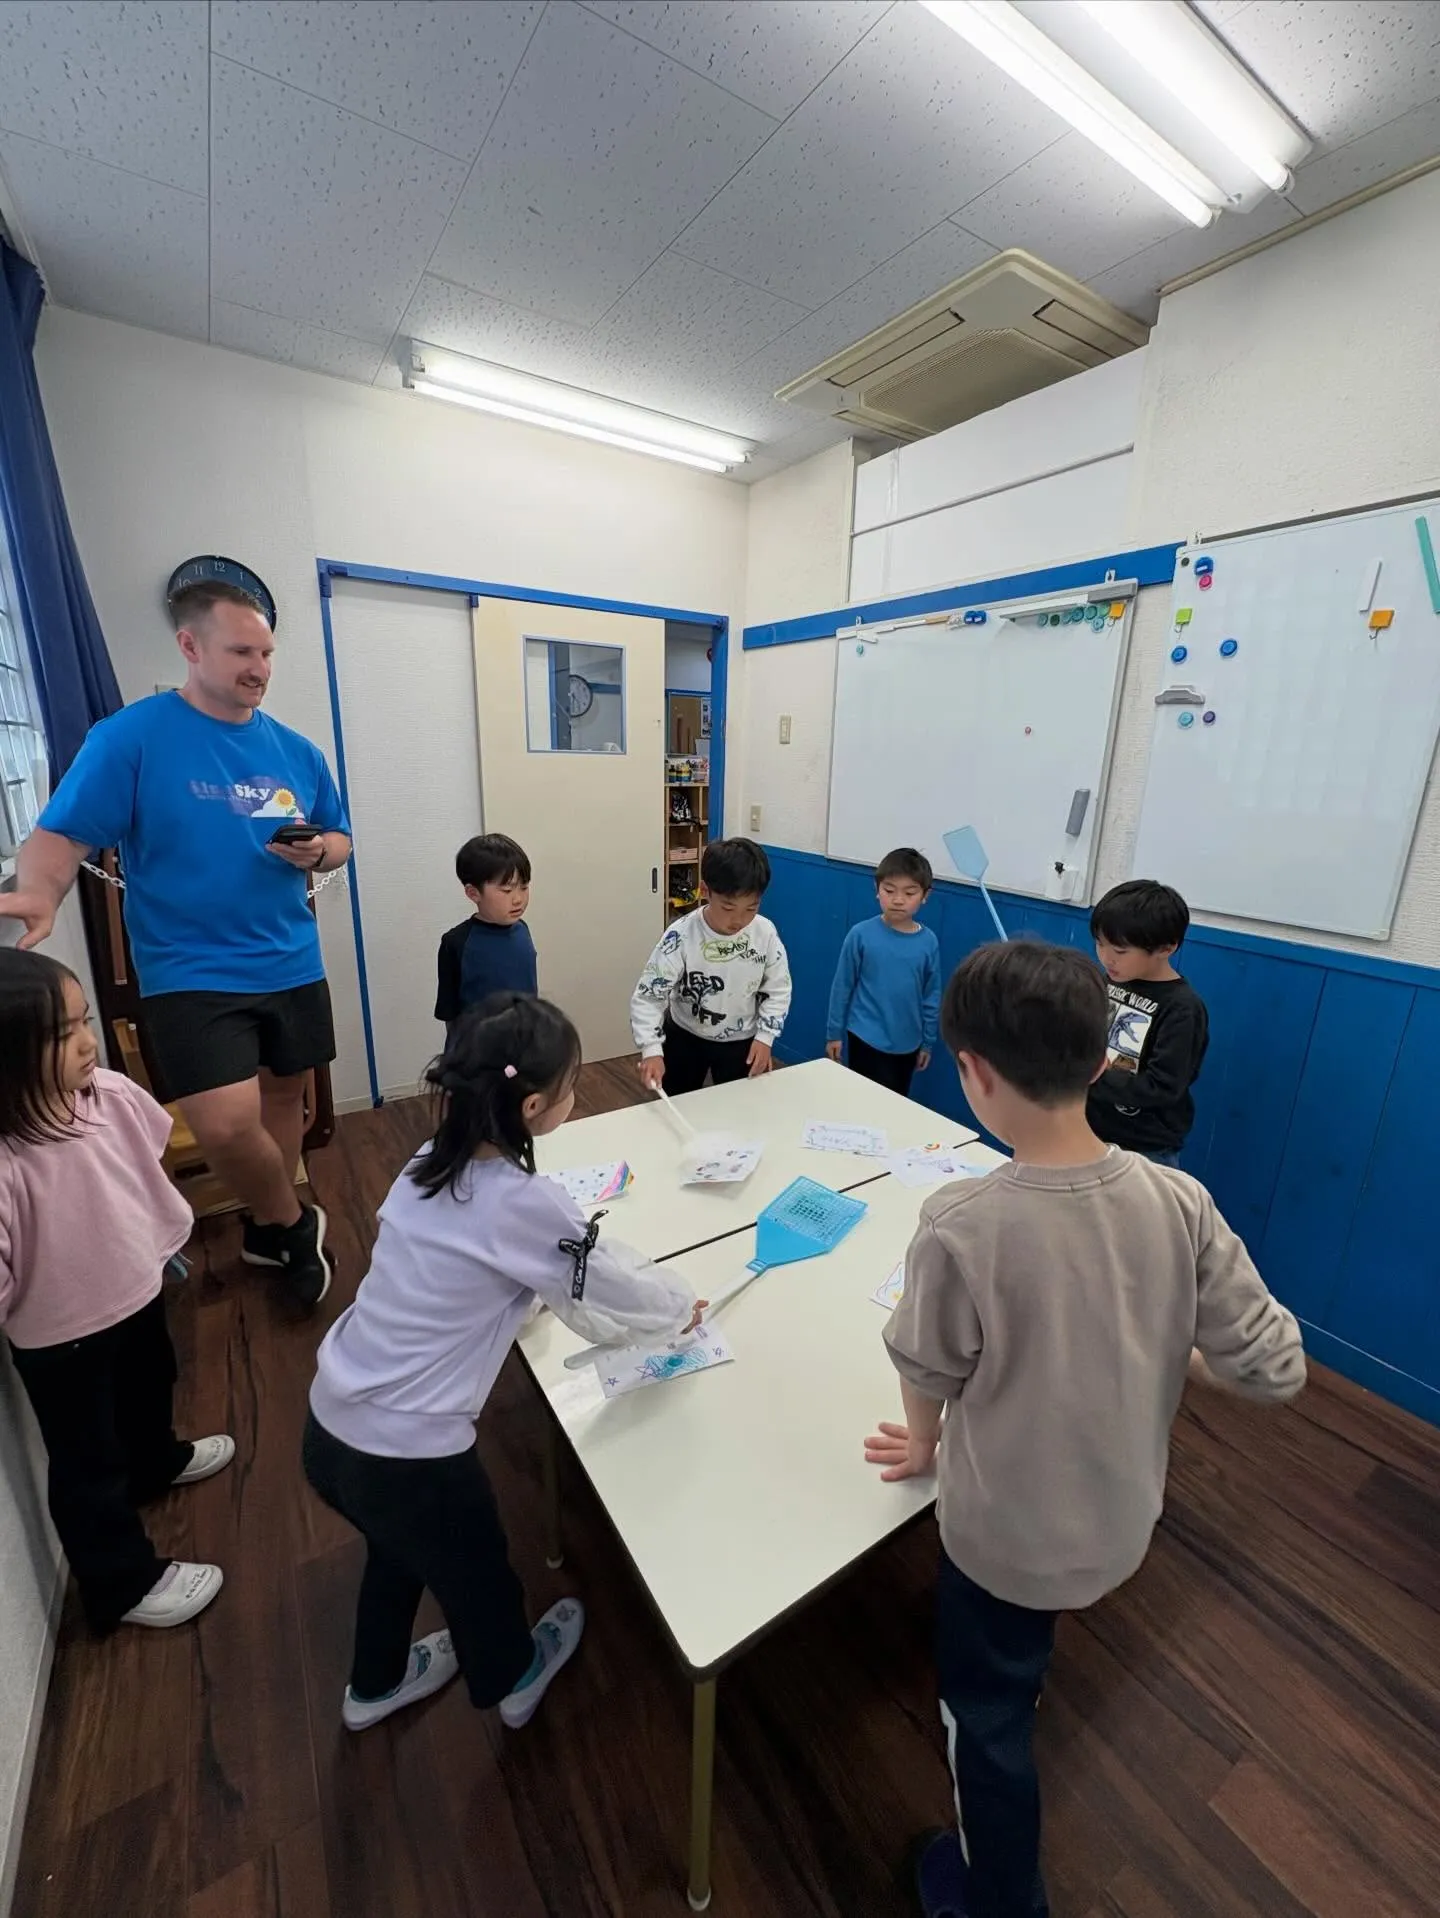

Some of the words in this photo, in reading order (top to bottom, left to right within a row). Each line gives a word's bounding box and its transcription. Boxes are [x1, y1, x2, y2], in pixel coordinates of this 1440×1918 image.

[194, 565, 203, 576] 11
[213, 560, 226, 573] 12
[255, 589, 262, 598] 2
[1129, 992, 1159, 1014] WORLD
